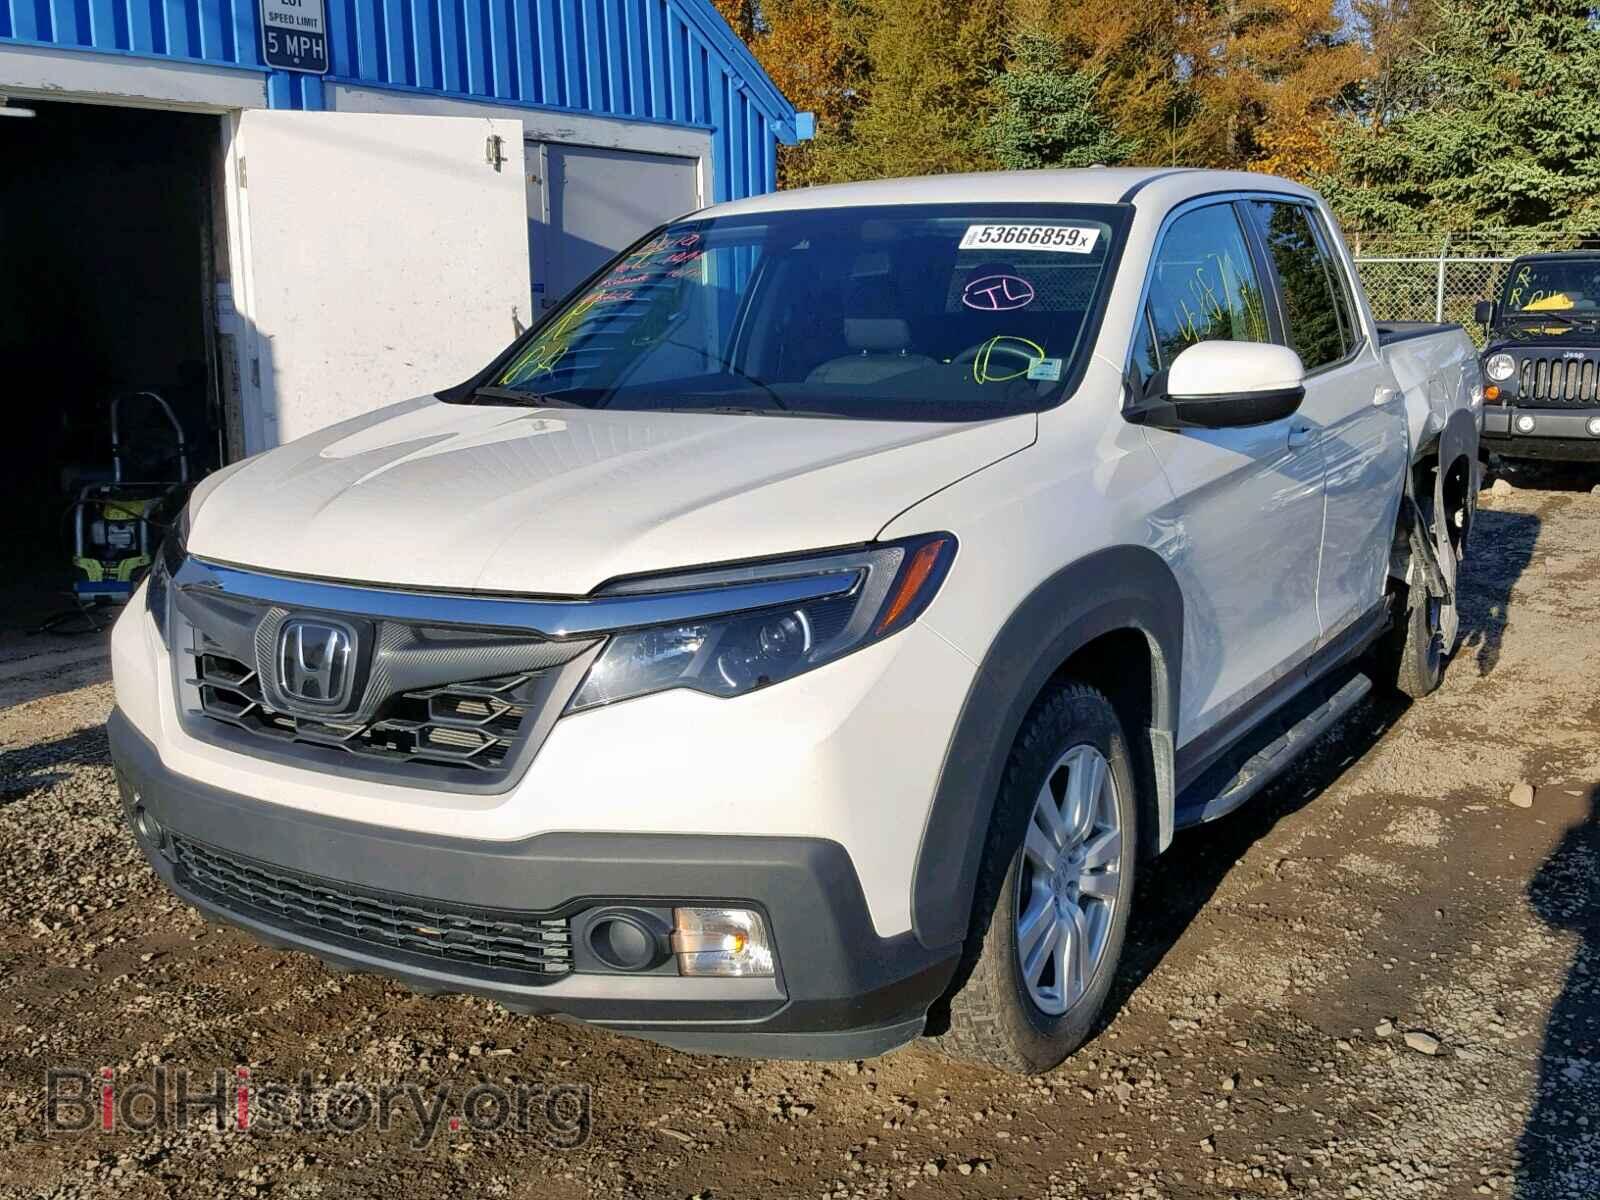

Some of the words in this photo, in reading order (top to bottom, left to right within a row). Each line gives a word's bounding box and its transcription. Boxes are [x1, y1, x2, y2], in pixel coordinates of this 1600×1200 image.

[268, 11, 294, 24] SPEED
[296, 16, 318, 28] LIMIT
[268, 32, 279, 53] 5
[285, 34, 324, 59] MPH
[1562, 351, 1585, 360] Jeep
